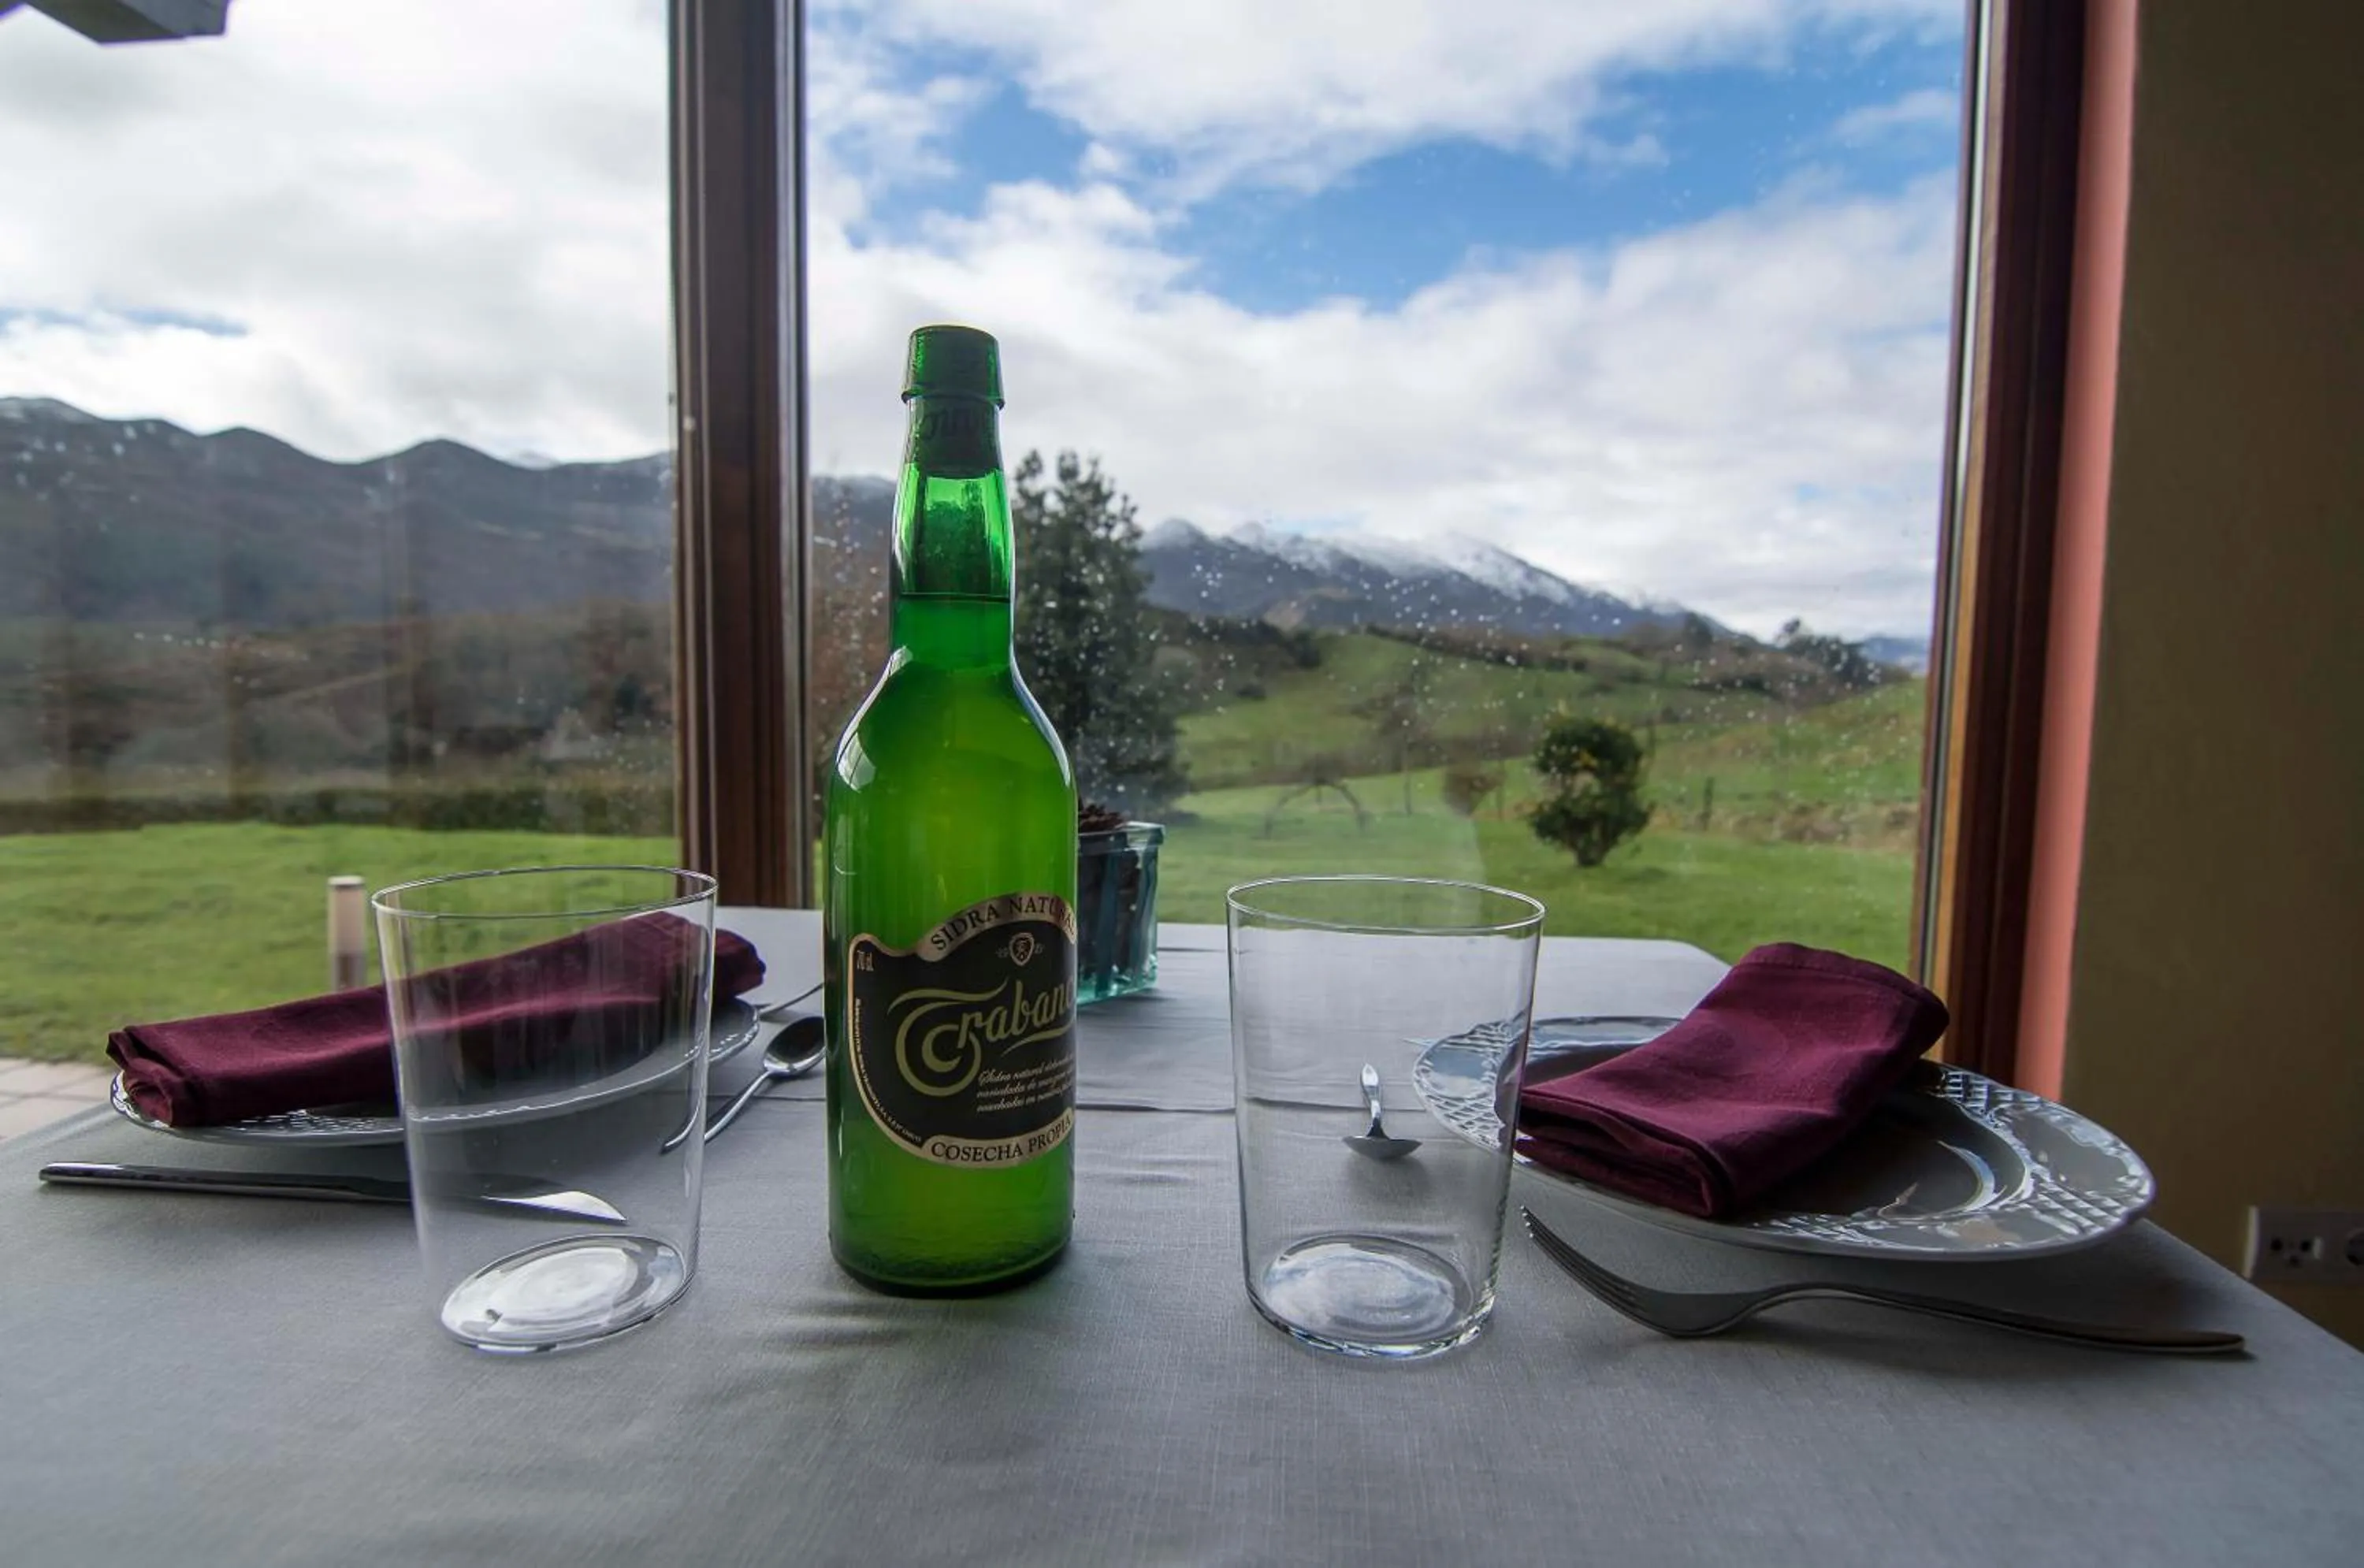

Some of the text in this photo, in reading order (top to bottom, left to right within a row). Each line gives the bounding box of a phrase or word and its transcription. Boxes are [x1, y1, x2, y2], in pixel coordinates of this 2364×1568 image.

[931, 904, 1001, 950] SIDRA
[931, 1114, 1071, 1162] COSECHA PROPIA
